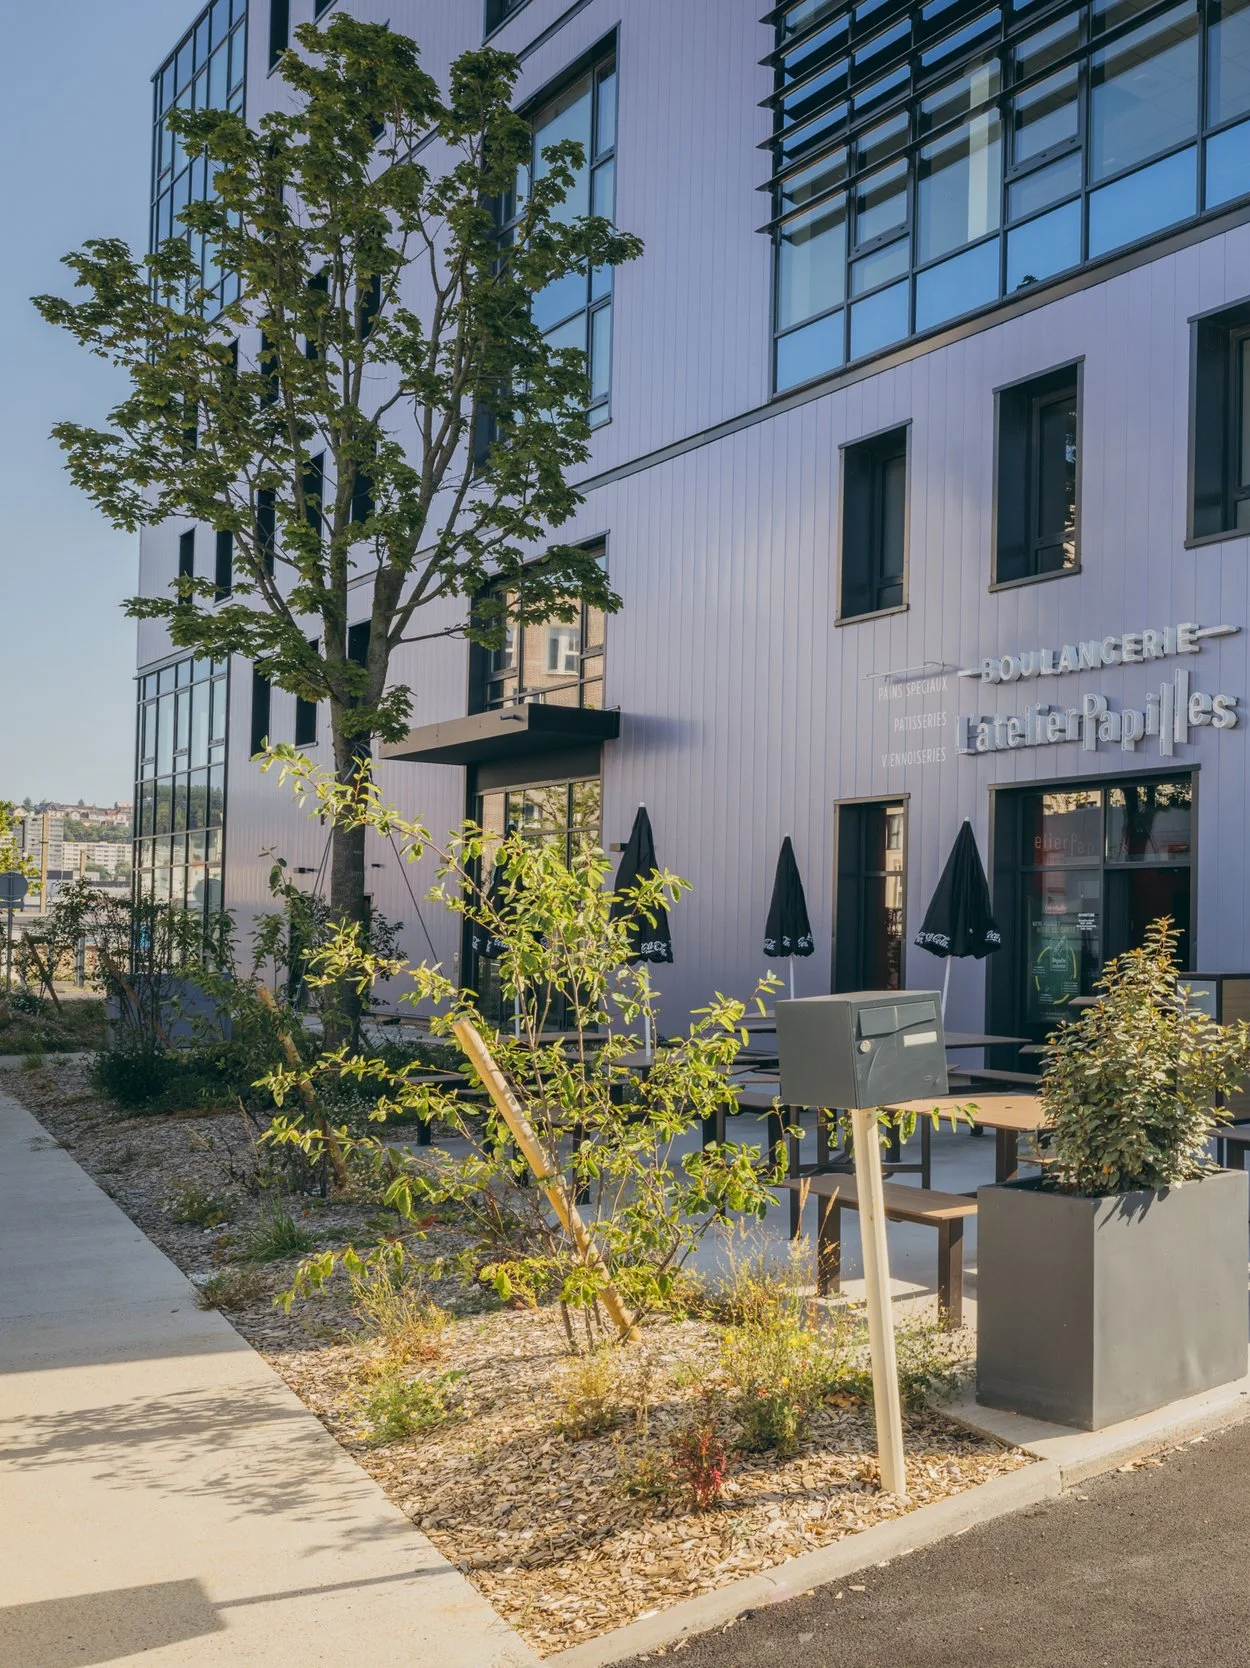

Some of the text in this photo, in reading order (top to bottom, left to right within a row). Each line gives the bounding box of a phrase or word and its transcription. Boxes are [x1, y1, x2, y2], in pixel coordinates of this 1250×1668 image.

[981, 622, 1200, 683] BOULANGERIE
[878, 683, 903, 701] PAINS
[881, 746, 946, 768] VENNOISERIES
